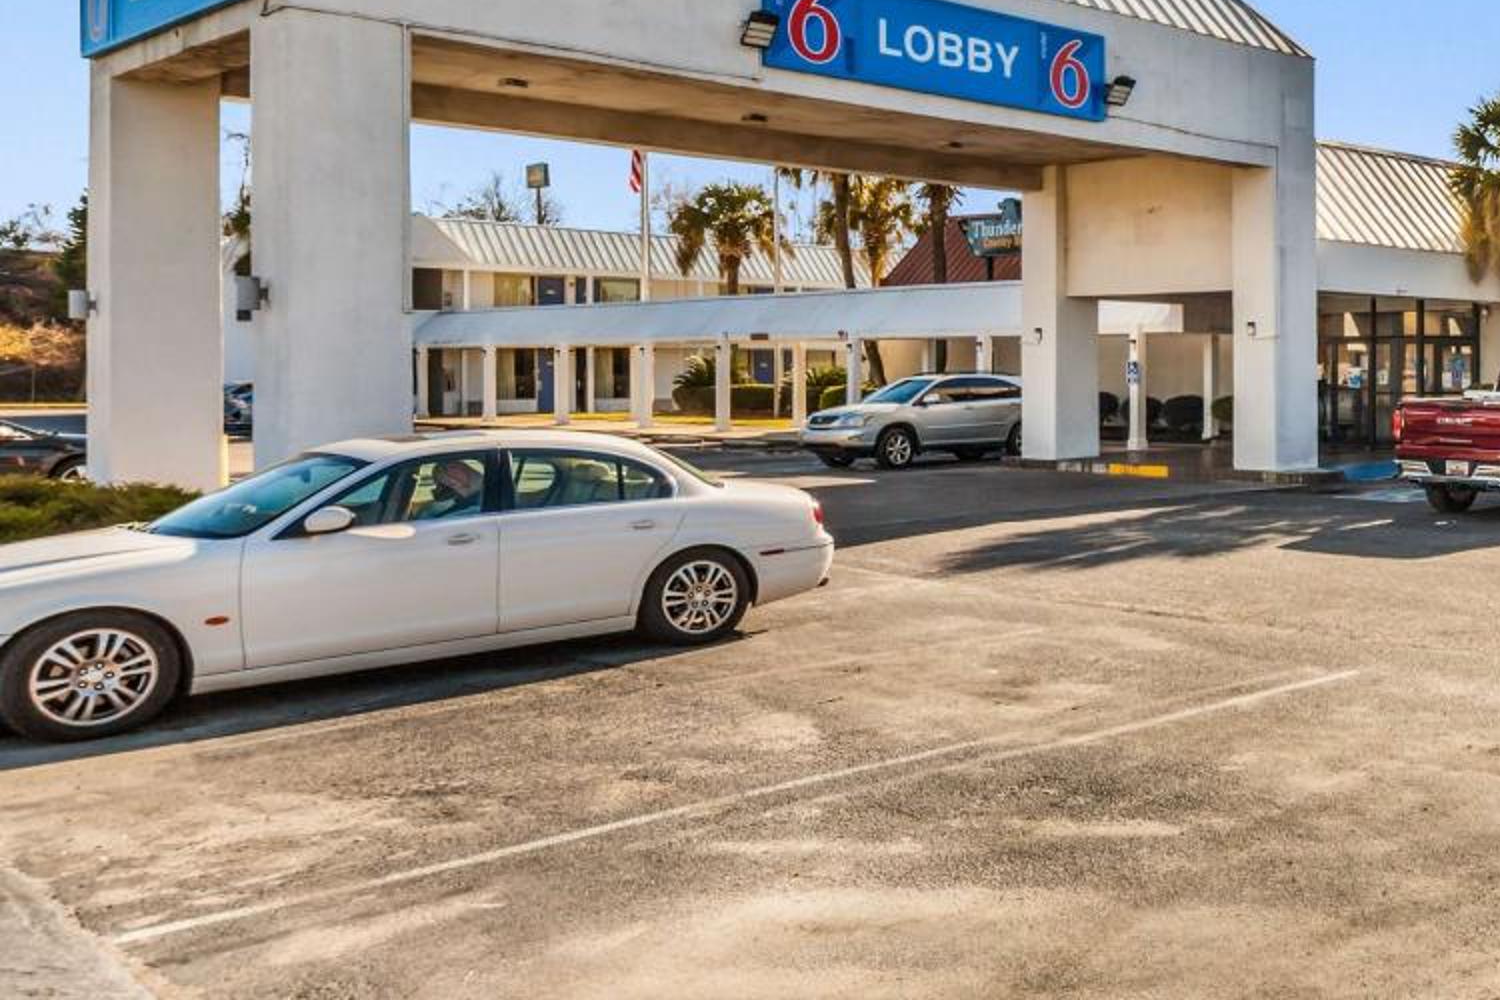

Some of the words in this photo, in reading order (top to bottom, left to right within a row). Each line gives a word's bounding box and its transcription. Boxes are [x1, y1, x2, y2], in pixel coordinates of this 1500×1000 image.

[879, 18, 1019, 78] LOBBY
[1051, 39, 1089, 108] 6
[973, 220, 1023, 238] Thunder
